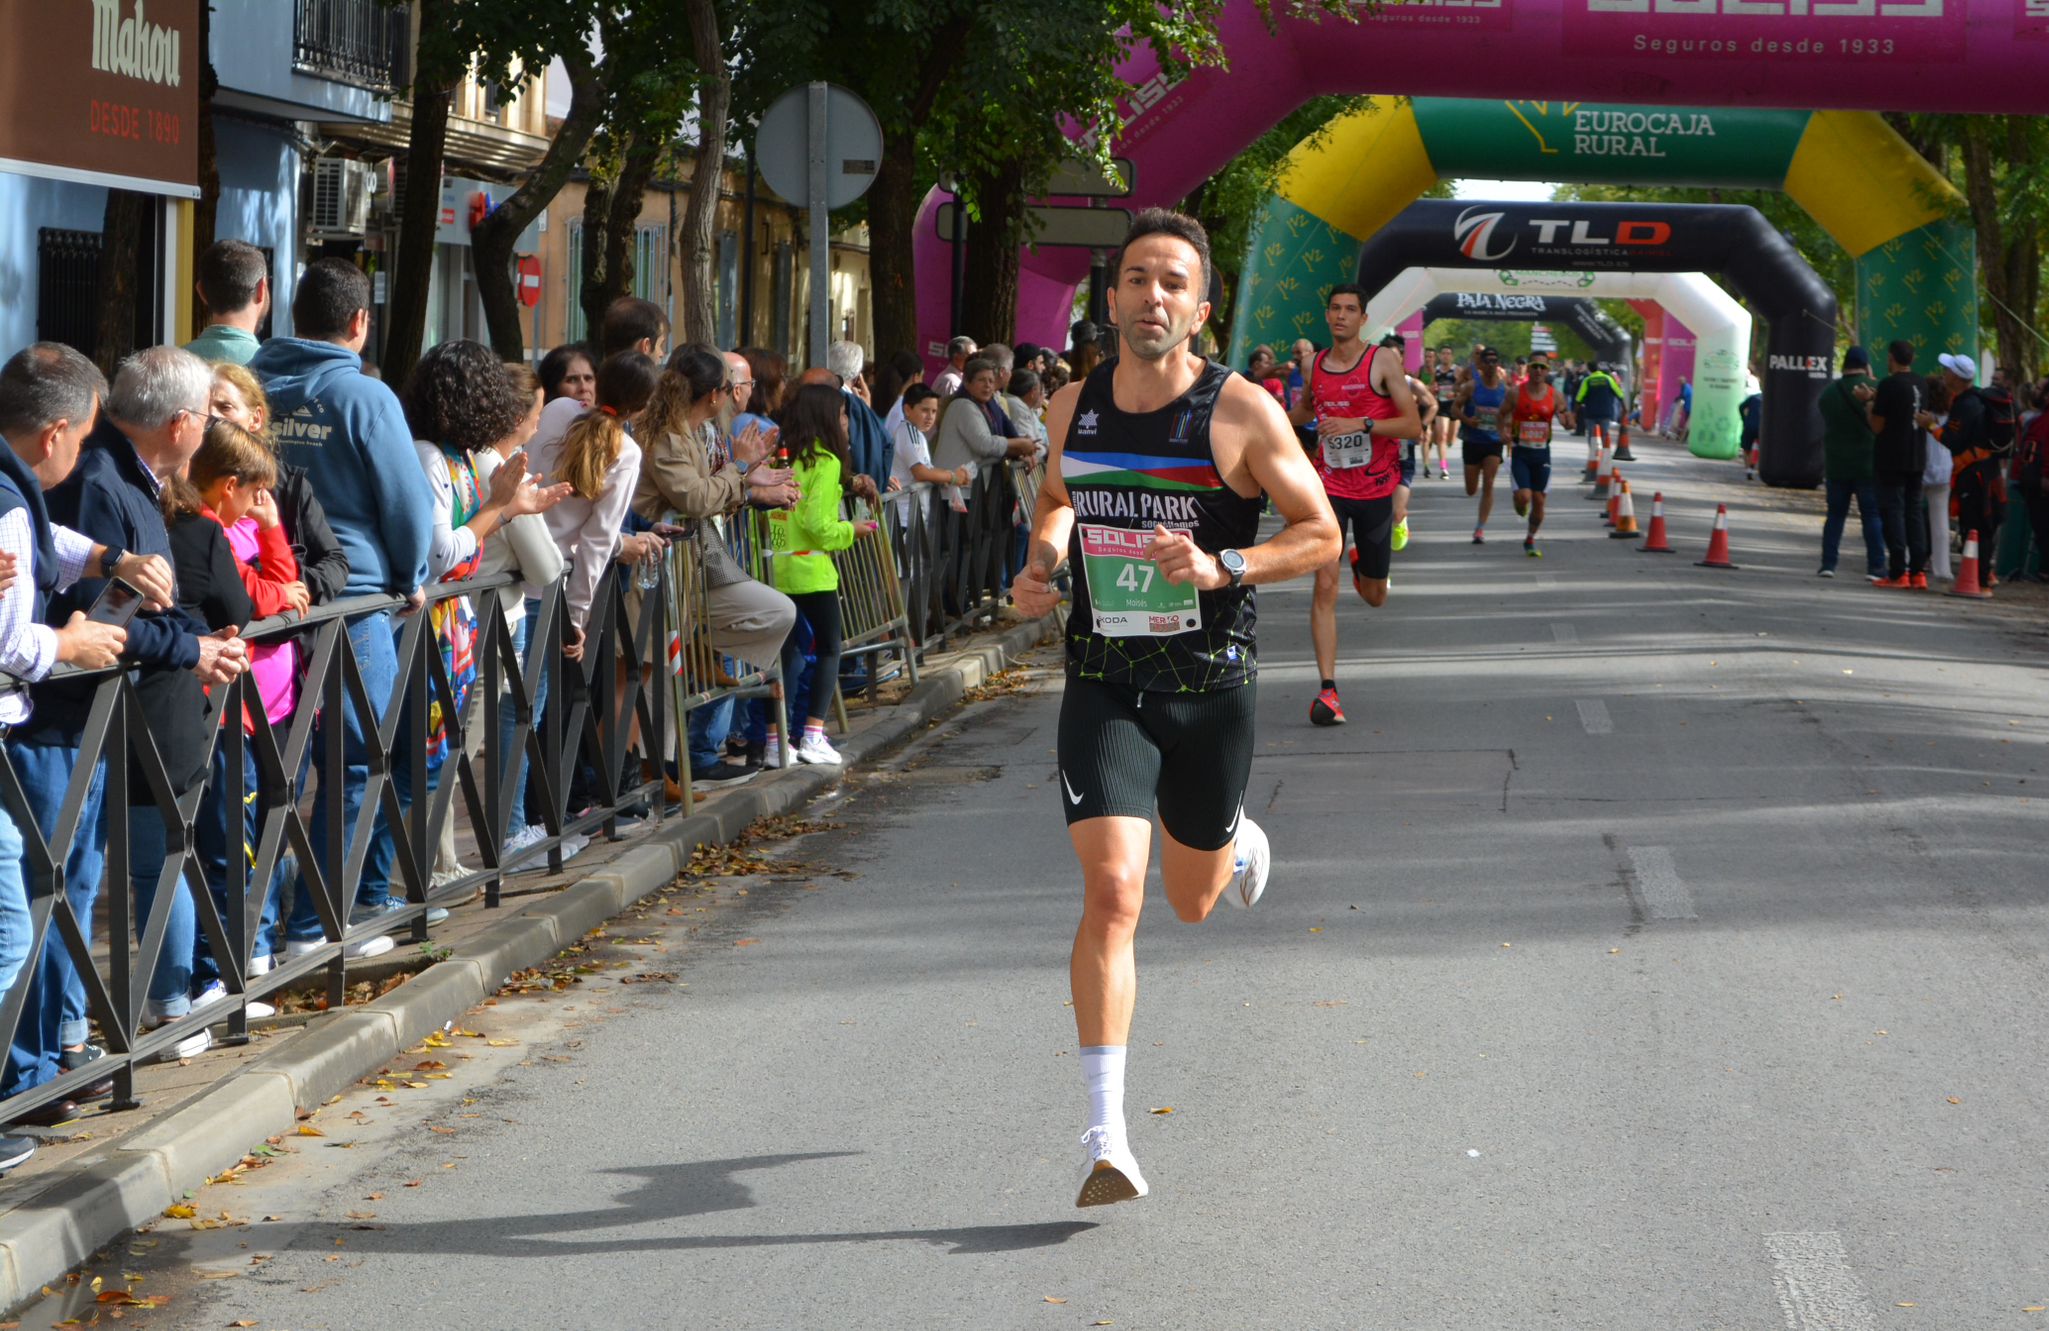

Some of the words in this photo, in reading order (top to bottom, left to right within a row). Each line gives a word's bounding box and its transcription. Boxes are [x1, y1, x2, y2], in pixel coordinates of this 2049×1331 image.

[92, 0, 181, 87] Mahou
[1633, 34, 1737, 54] Seguros
[1750, 37, 1825, 54] desde
[1839, 38, 1895, 54] 1933
[90, 99, 141, 140] DESDE
[148, 109, 182, 145] 1890
[1574, 110, 1716, 136] EUROCAJA
[1574, 134, 1667, 157] RURAL
[1528, 219, 1672, 246] TLD
[1769, 354, 1828, 372] PALLEX
[270, 418, 332, 440] silver
[1076, 490, 1139, 518] RURAL
[1140, 493, 1199, 521] PARK
[1115, 563, 1155, 593] 47
